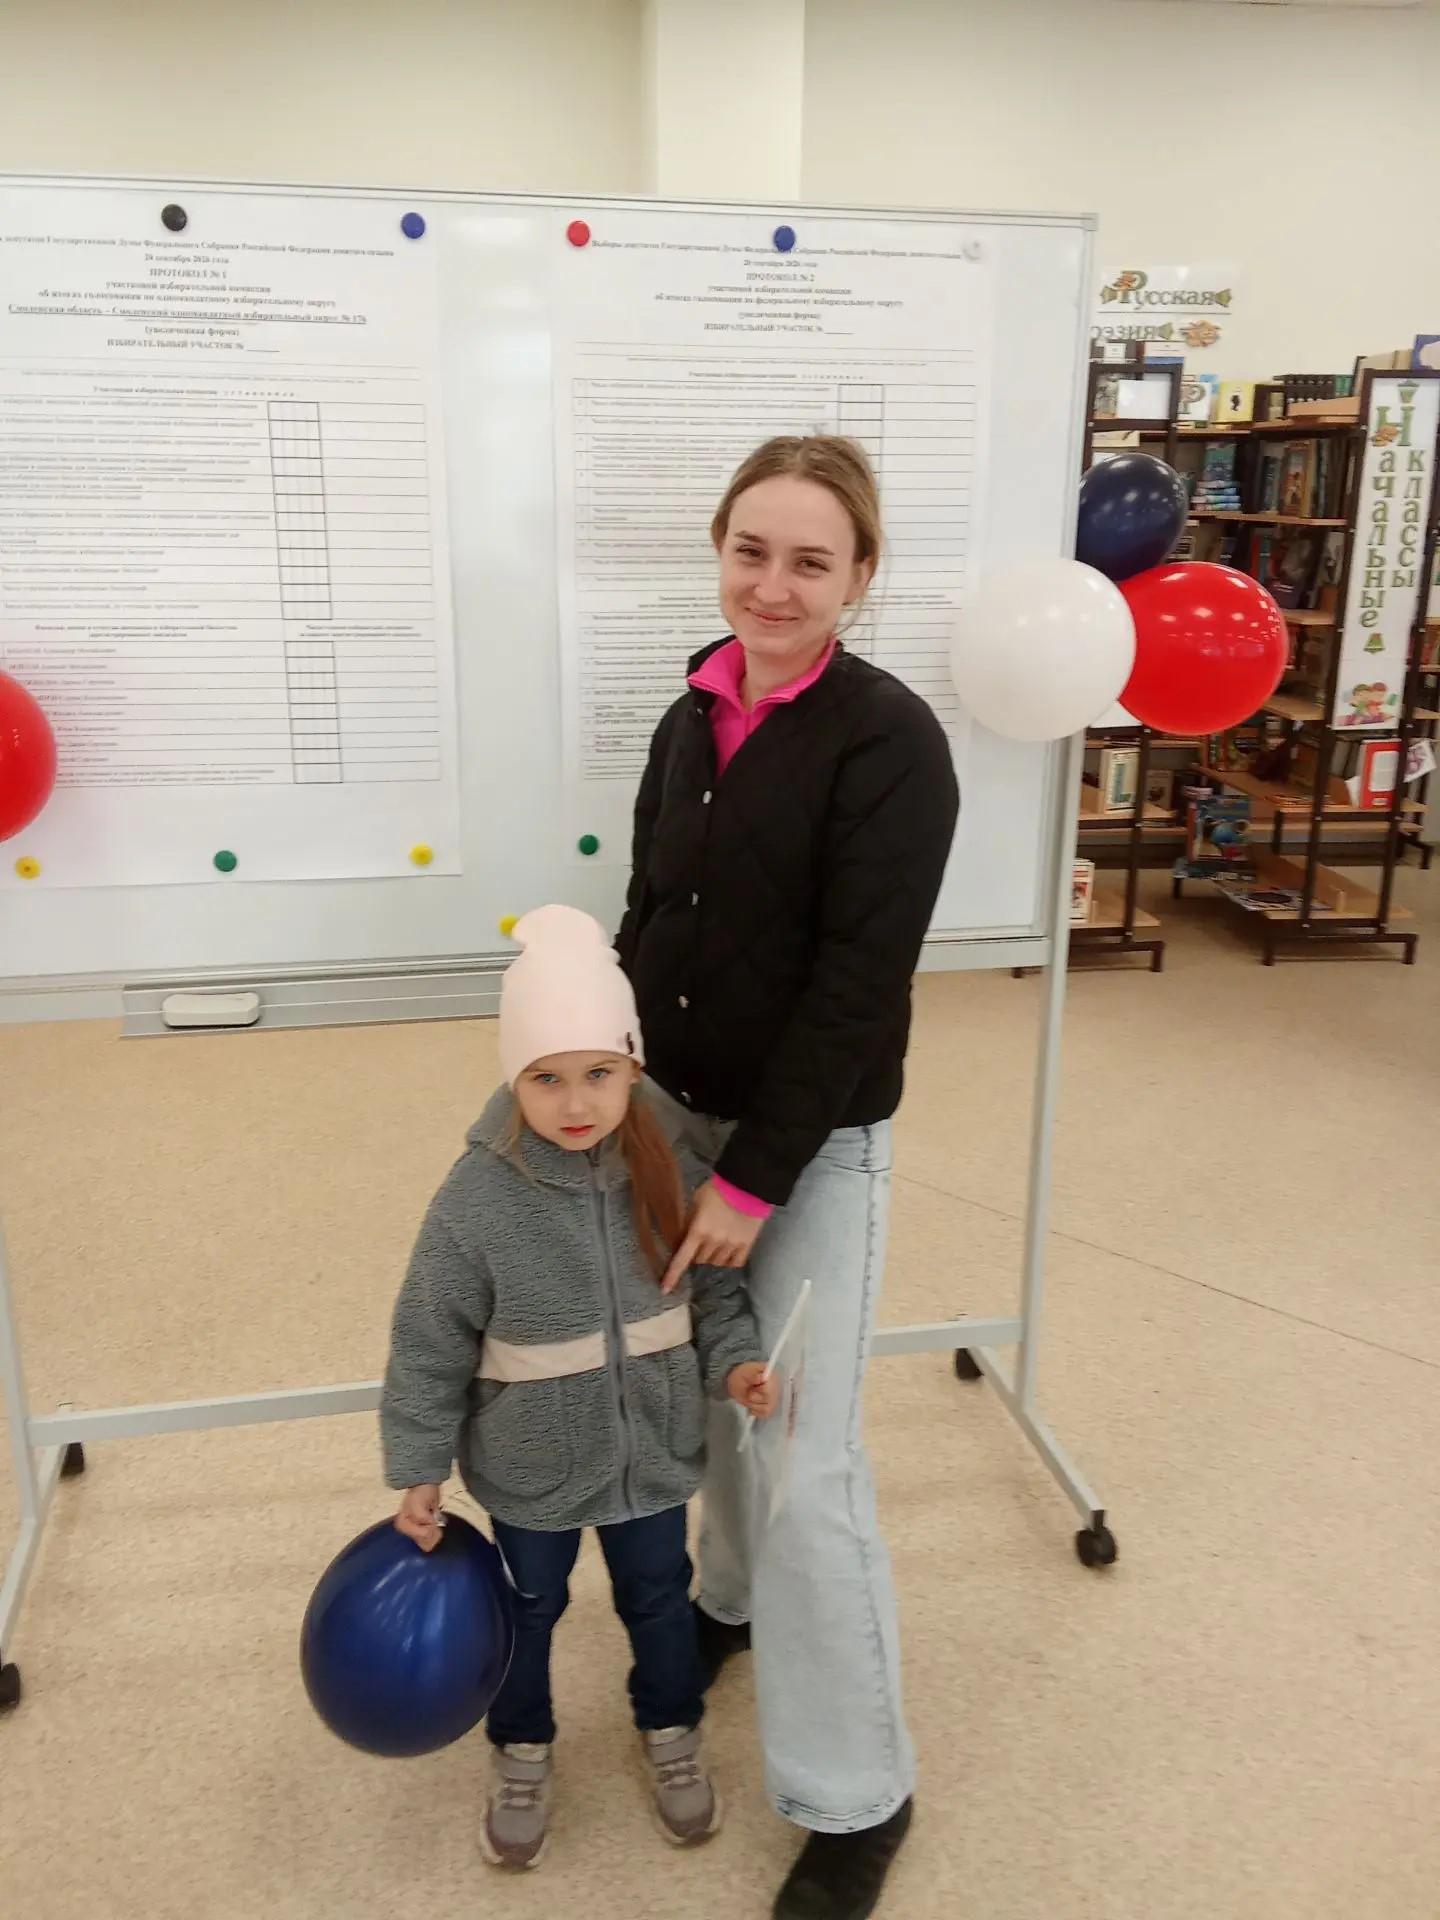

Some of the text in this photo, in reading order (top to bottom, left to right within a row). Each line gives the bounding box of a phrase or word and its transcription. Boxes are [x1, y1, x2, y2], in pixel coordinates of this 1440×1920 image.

[1113, 269, 1216, 311] Русская
[1359, 405, 1416, 629] Начальные
[1390, 449, 1425, 589] классы
